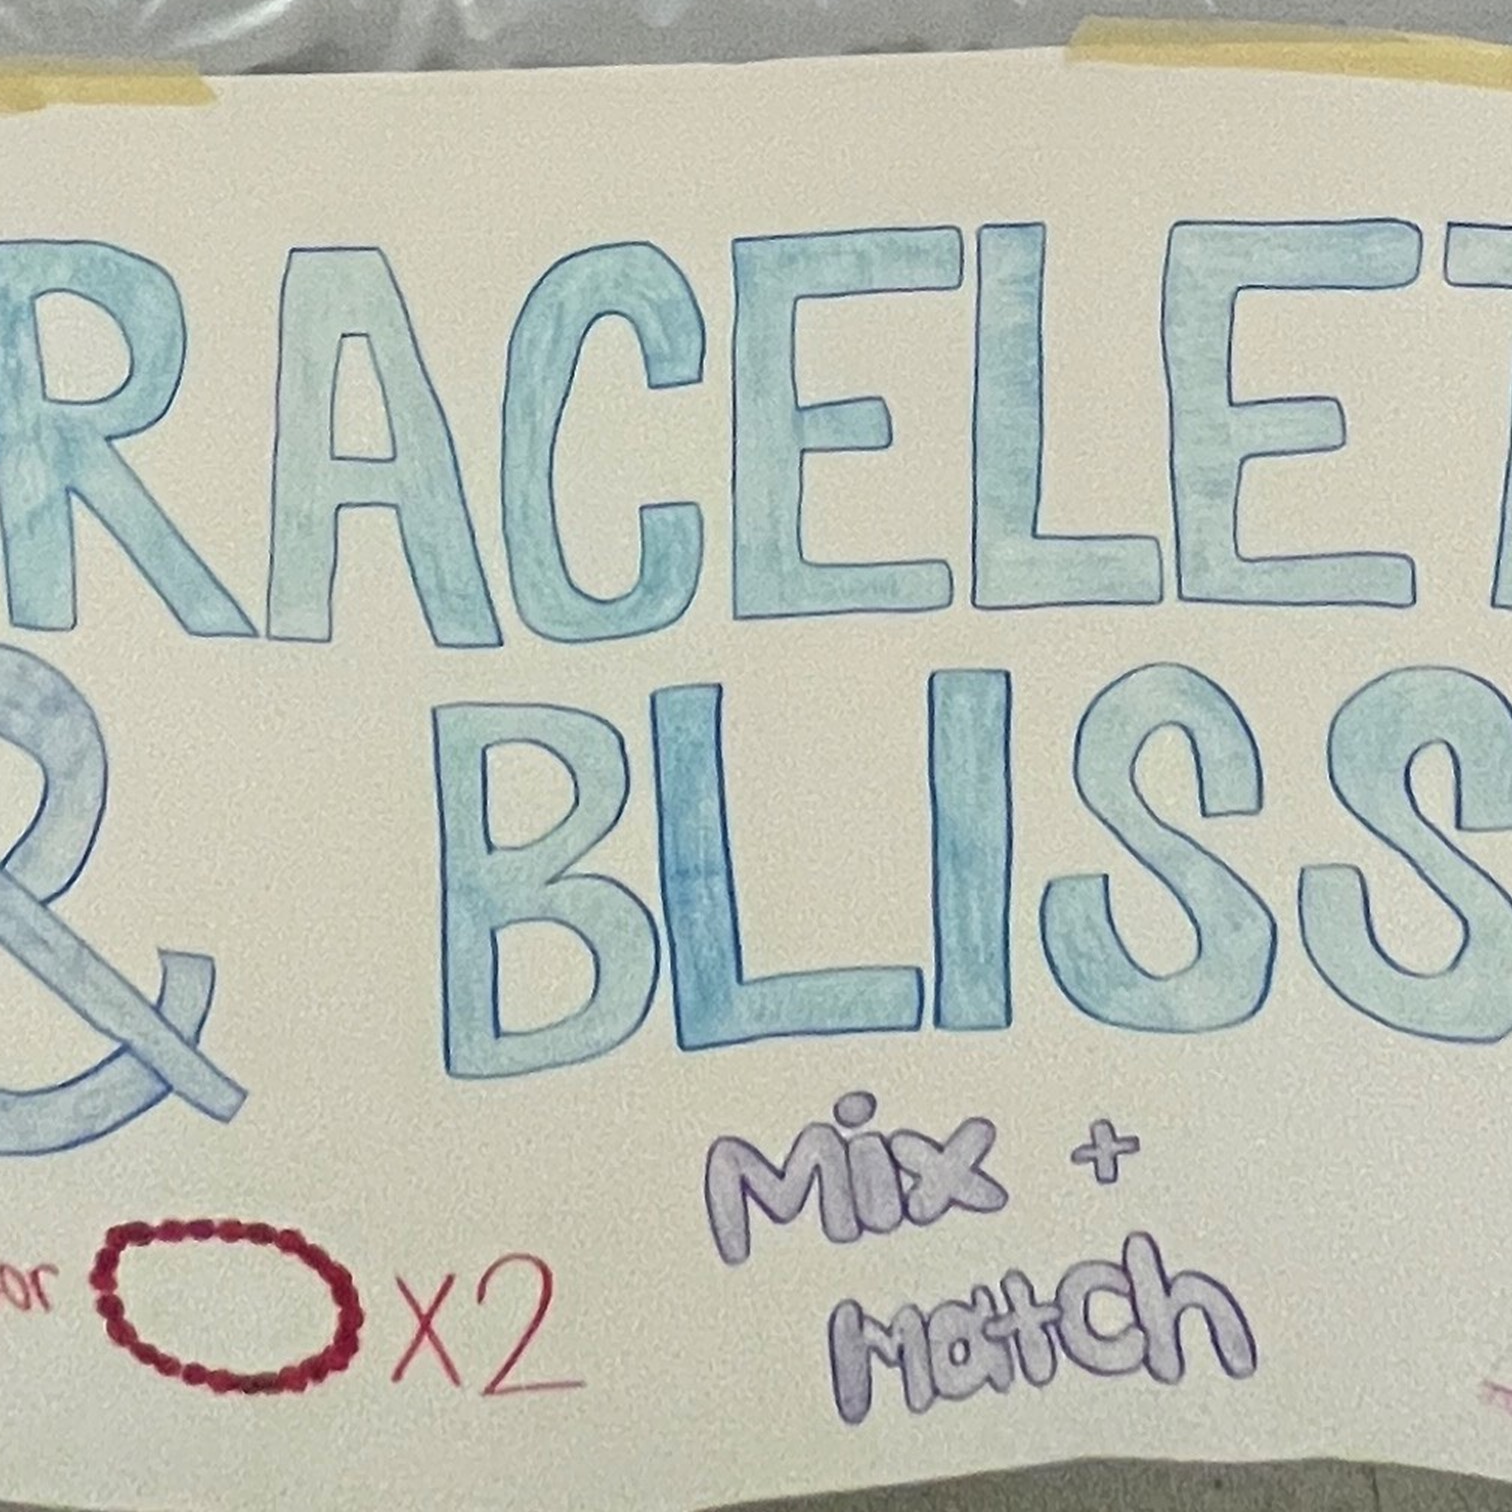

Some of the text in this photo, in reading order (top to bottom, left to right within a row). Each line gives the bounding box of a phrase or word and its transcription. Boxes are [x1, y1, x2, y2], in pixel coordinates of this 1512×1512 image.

[704, 1089, 1141, 1266] Mix +
[828, 1230, 1258, 1425] Match
